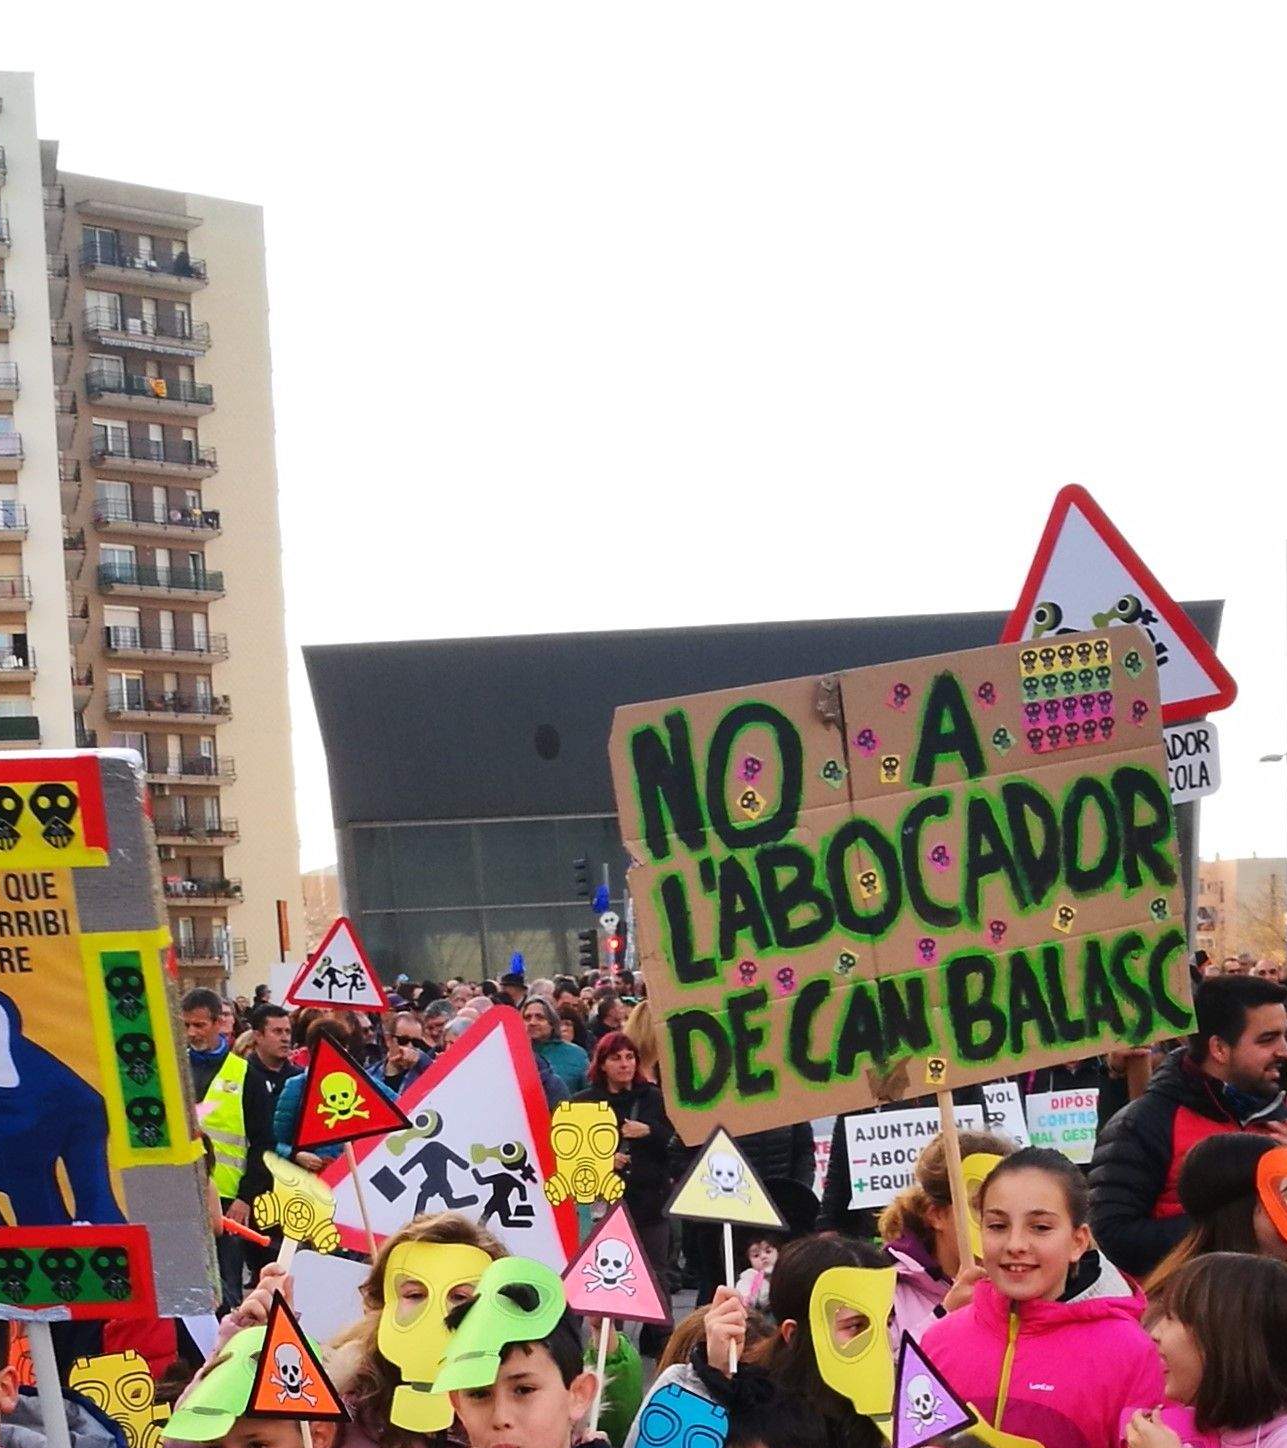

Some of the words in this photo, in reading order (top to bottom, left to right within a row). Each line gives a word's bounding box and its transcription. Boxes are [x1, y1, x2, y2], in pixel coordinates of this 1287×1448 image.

[632, 702, 804, 860] NO
[914, 671, 988, 787] A
[4, 872, 58, 902] QUE
[656, 767, 1176, 984] L'ABOCADOR
[667, 987, 777, 1108] DE
[789, 972, 932, 1084] CAN
[945, 931, 1193, 1062] BALASC
[855, 1118, 975, 1142] AJUNTAMT
